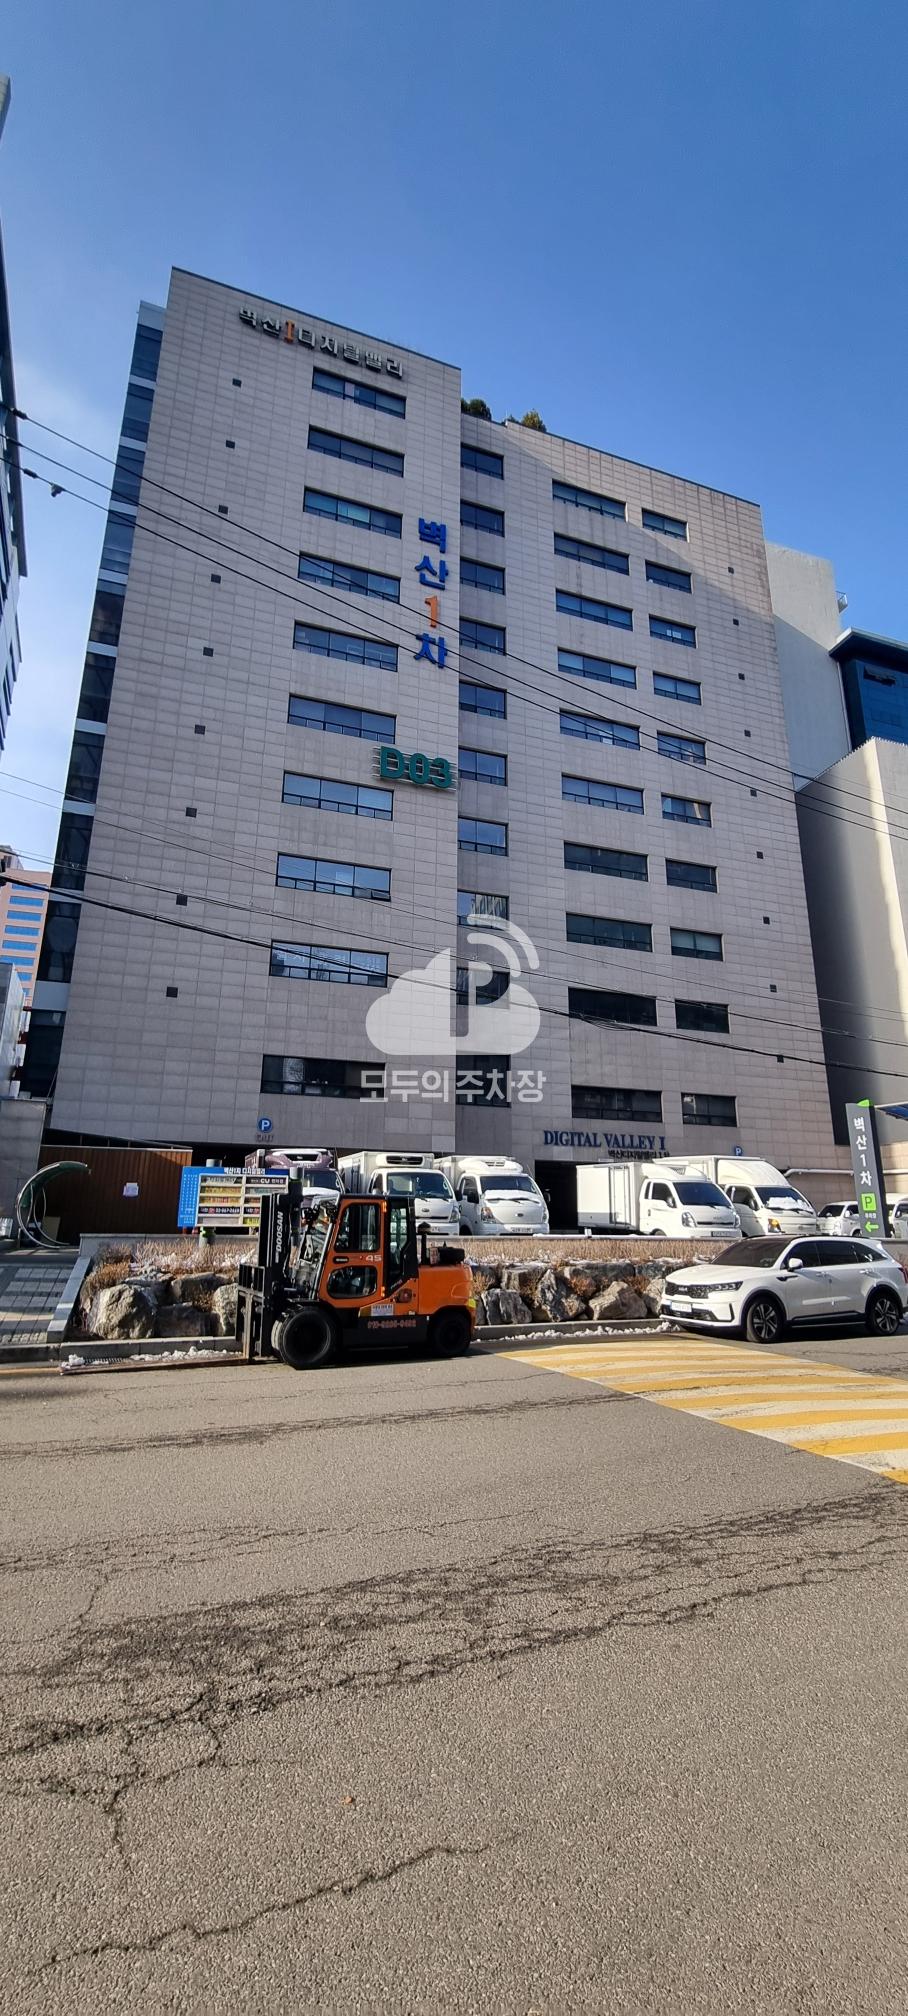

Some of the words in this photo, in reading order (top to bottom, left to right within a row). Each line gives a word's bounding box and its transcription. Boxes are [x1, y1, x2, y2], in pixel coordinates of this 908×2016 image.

[413, 518, 449, 669] 벽산1차
[380, 746, 452, 788] D03
[543, 1130, 602, 1148] DIGITAL
[602, 1132, 655, 1150] VALLEY
[853, 1116, 872, 1186] 벽산1차
[275, 1210, 284, 1253] DOOSAN
[365, 1254, 382, 1262] 45
